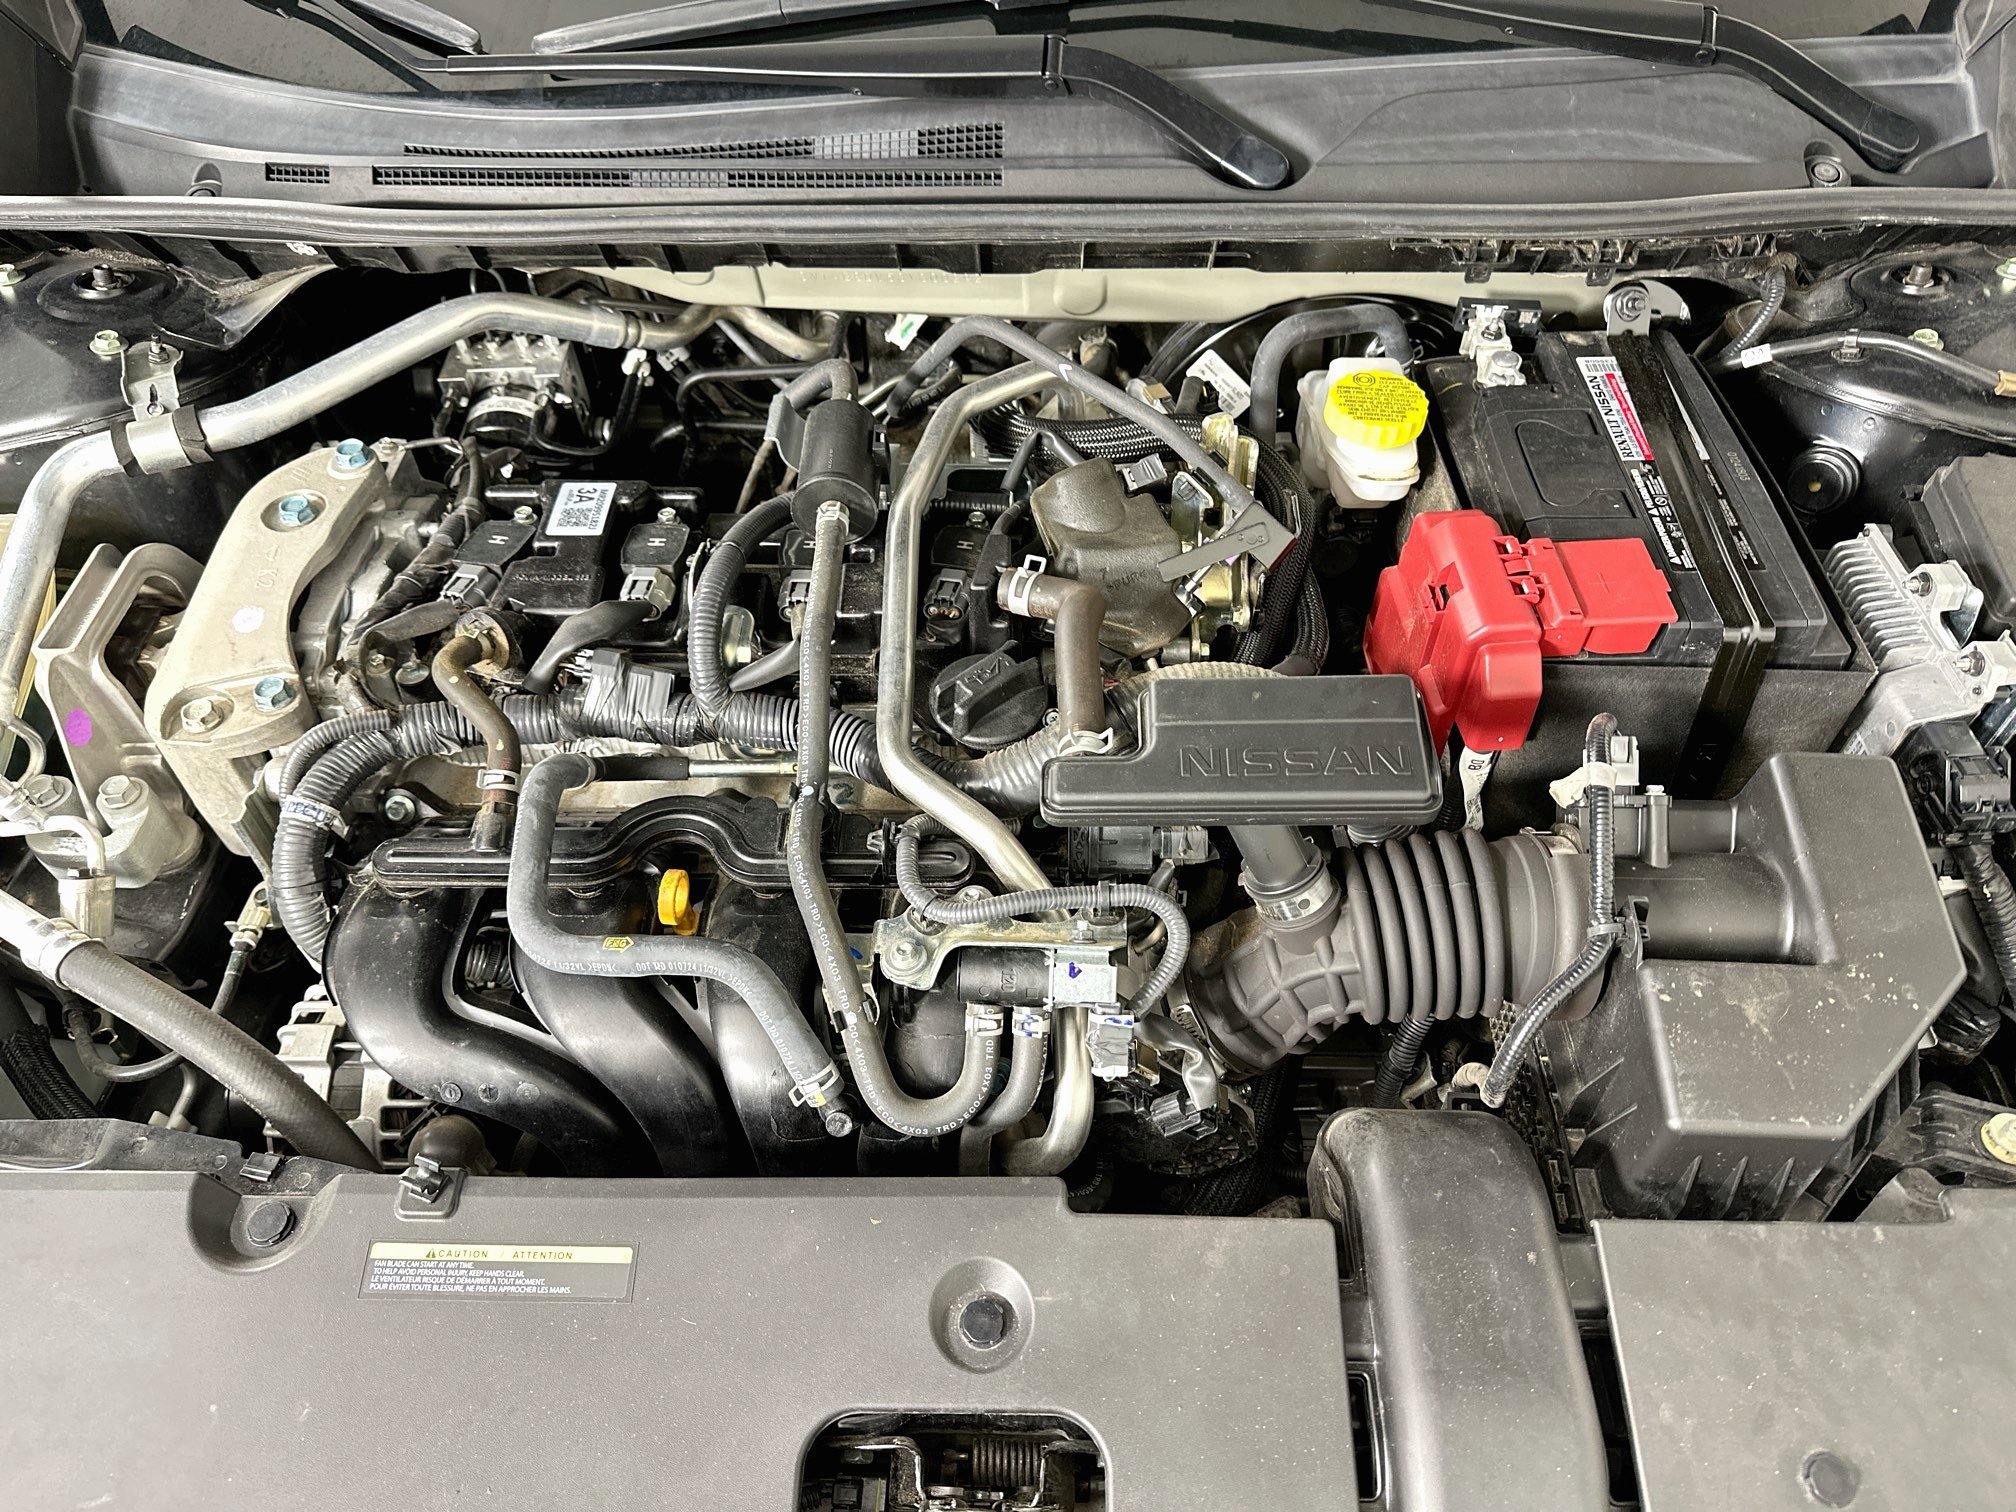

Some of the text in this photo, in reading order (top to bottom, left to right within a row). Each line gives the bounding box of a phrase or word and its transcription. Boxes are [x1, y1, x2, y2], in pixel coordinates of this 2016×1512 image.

[1586, 375, 1615, 416] NISSAN
[1607, 418, 1635, 458] RENAULT
[574, 488, 597, 504] 3A
[1179, 743, 1412, 780] NISSAN
[438, 1250, 572, 1260] CAUTION ATTENTION
